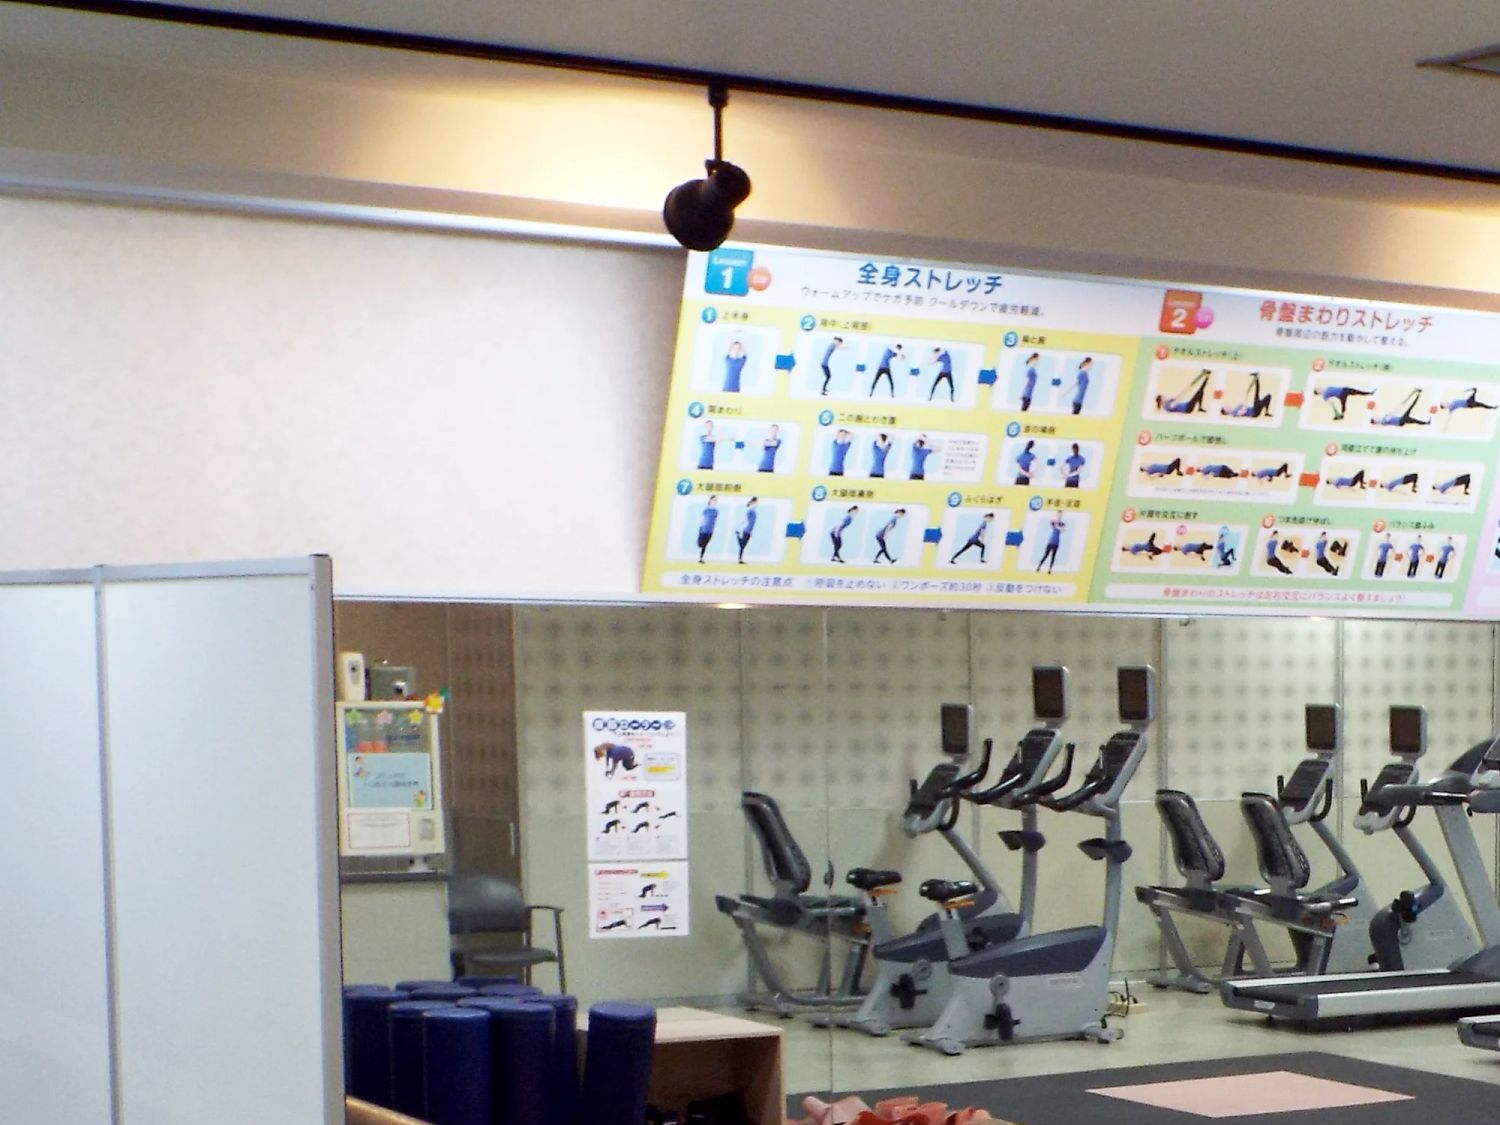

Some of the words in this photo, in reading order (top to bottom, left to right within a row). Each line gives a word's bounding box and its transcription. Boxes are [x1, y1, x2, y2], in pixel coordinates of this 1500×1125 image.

[719, 266, 732, 290] 1
[857, 262, 1004, 295] 全身ストレッチ
[1169, 307, 1187, 330] 2
[1259, 299, 1435, 334] 骨盤まわりストレッチ
